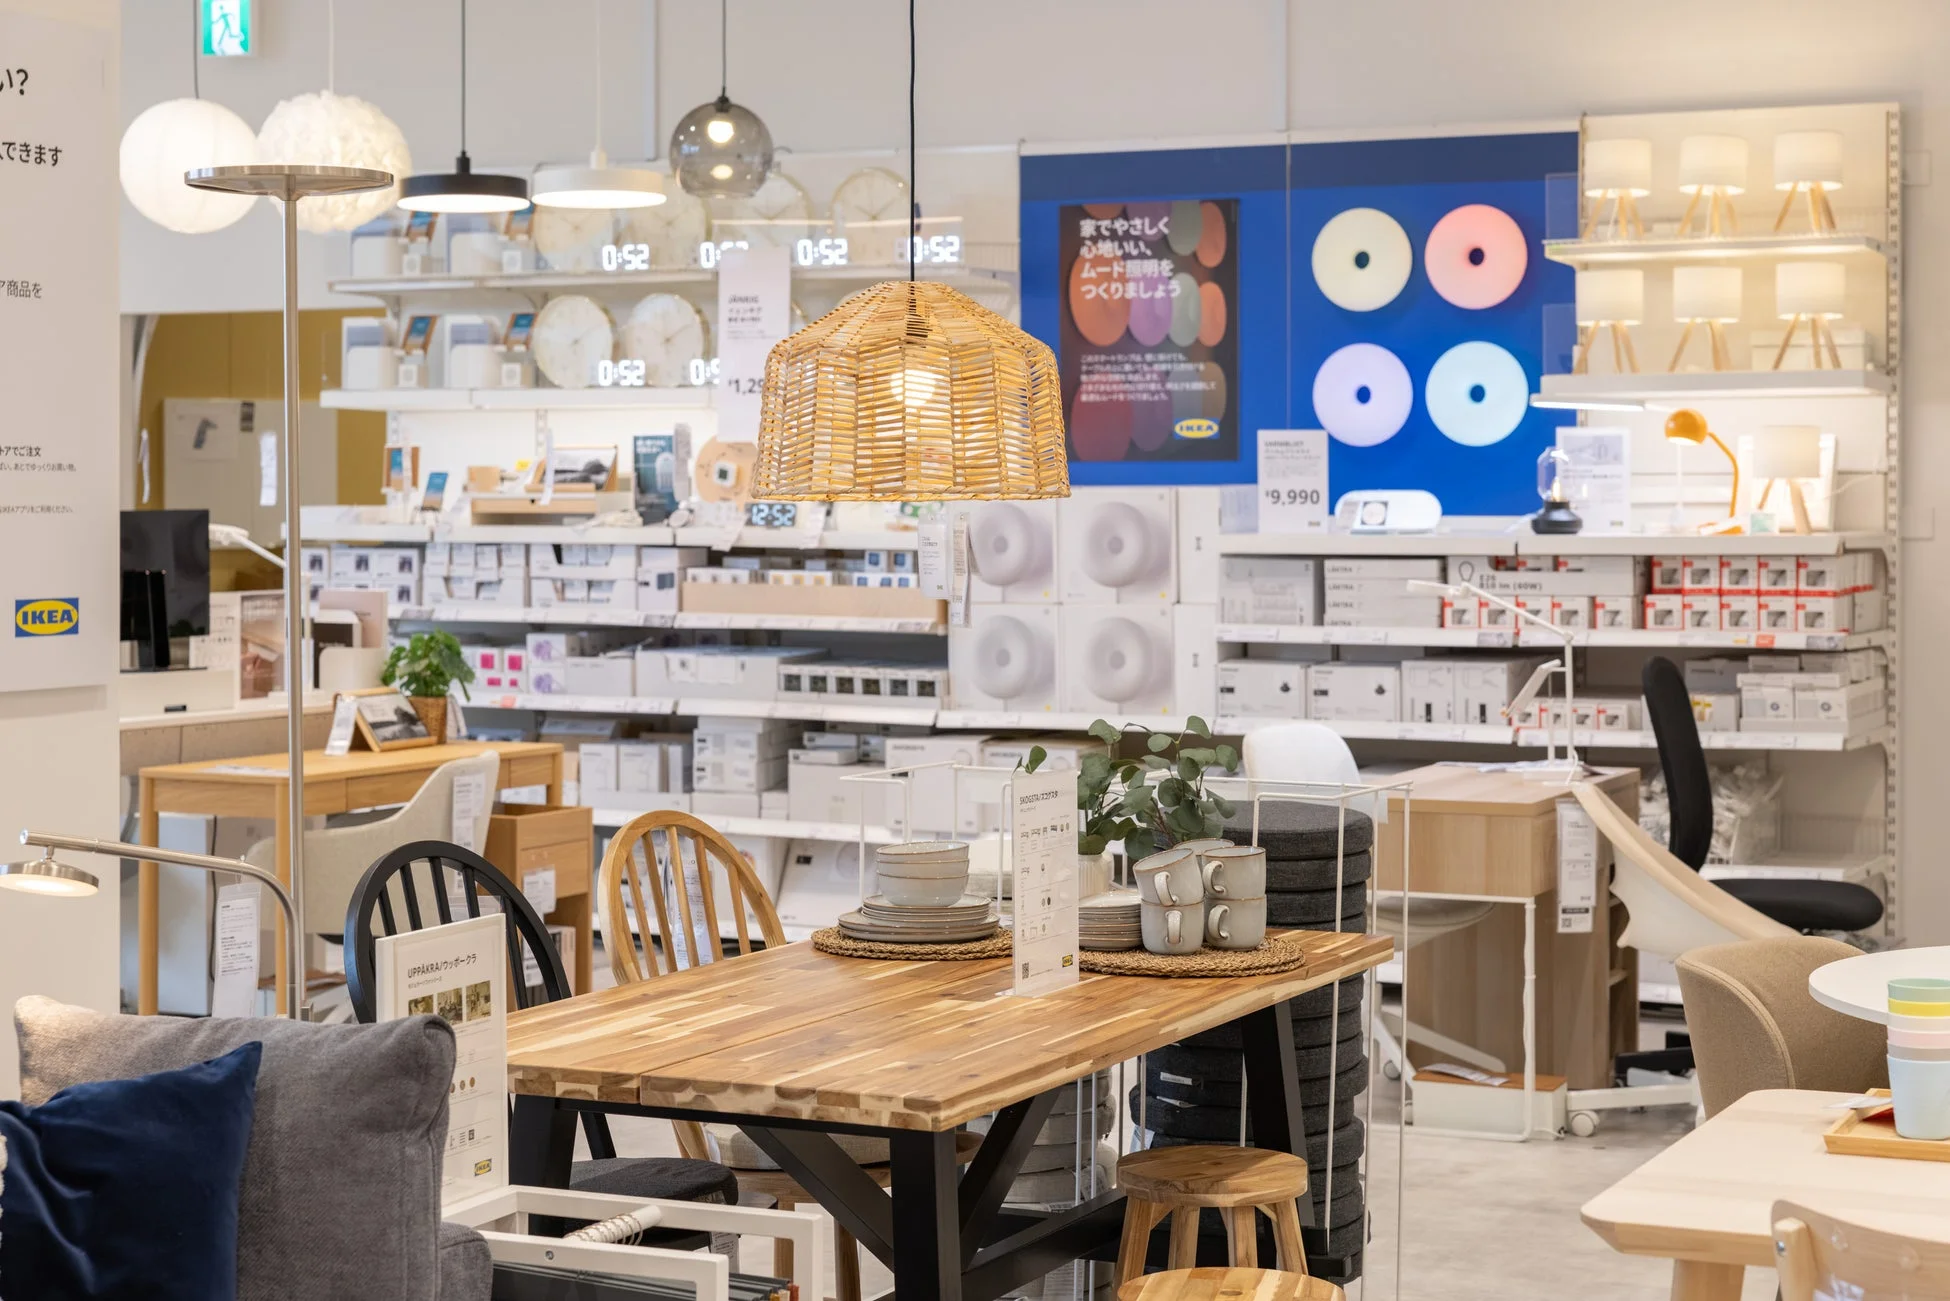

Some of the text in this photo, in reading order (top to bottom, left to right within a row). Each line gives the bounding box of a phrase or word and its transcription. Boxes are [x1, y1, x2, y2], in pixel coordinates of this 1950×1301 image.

[0, 142, 62, 167] できます
[1080, 217, 1170, 238] 家でやさしく
[602, 244, 650, 270] 0:52
[798, 238, 848, 266] 0:52
[1080, 239, 1153, 259] 心地いい、
[1080, 259, 1175, 278] ムード照明を
[1081, 280, 1181, 300] つくりましょう
[598, 359, 646, 387] 0:52
[728, 378, 764, 396] ¥1,29
[1265, 488, 1321, 507] ¥9,990
[22, 609, 74, 625] IKEA
